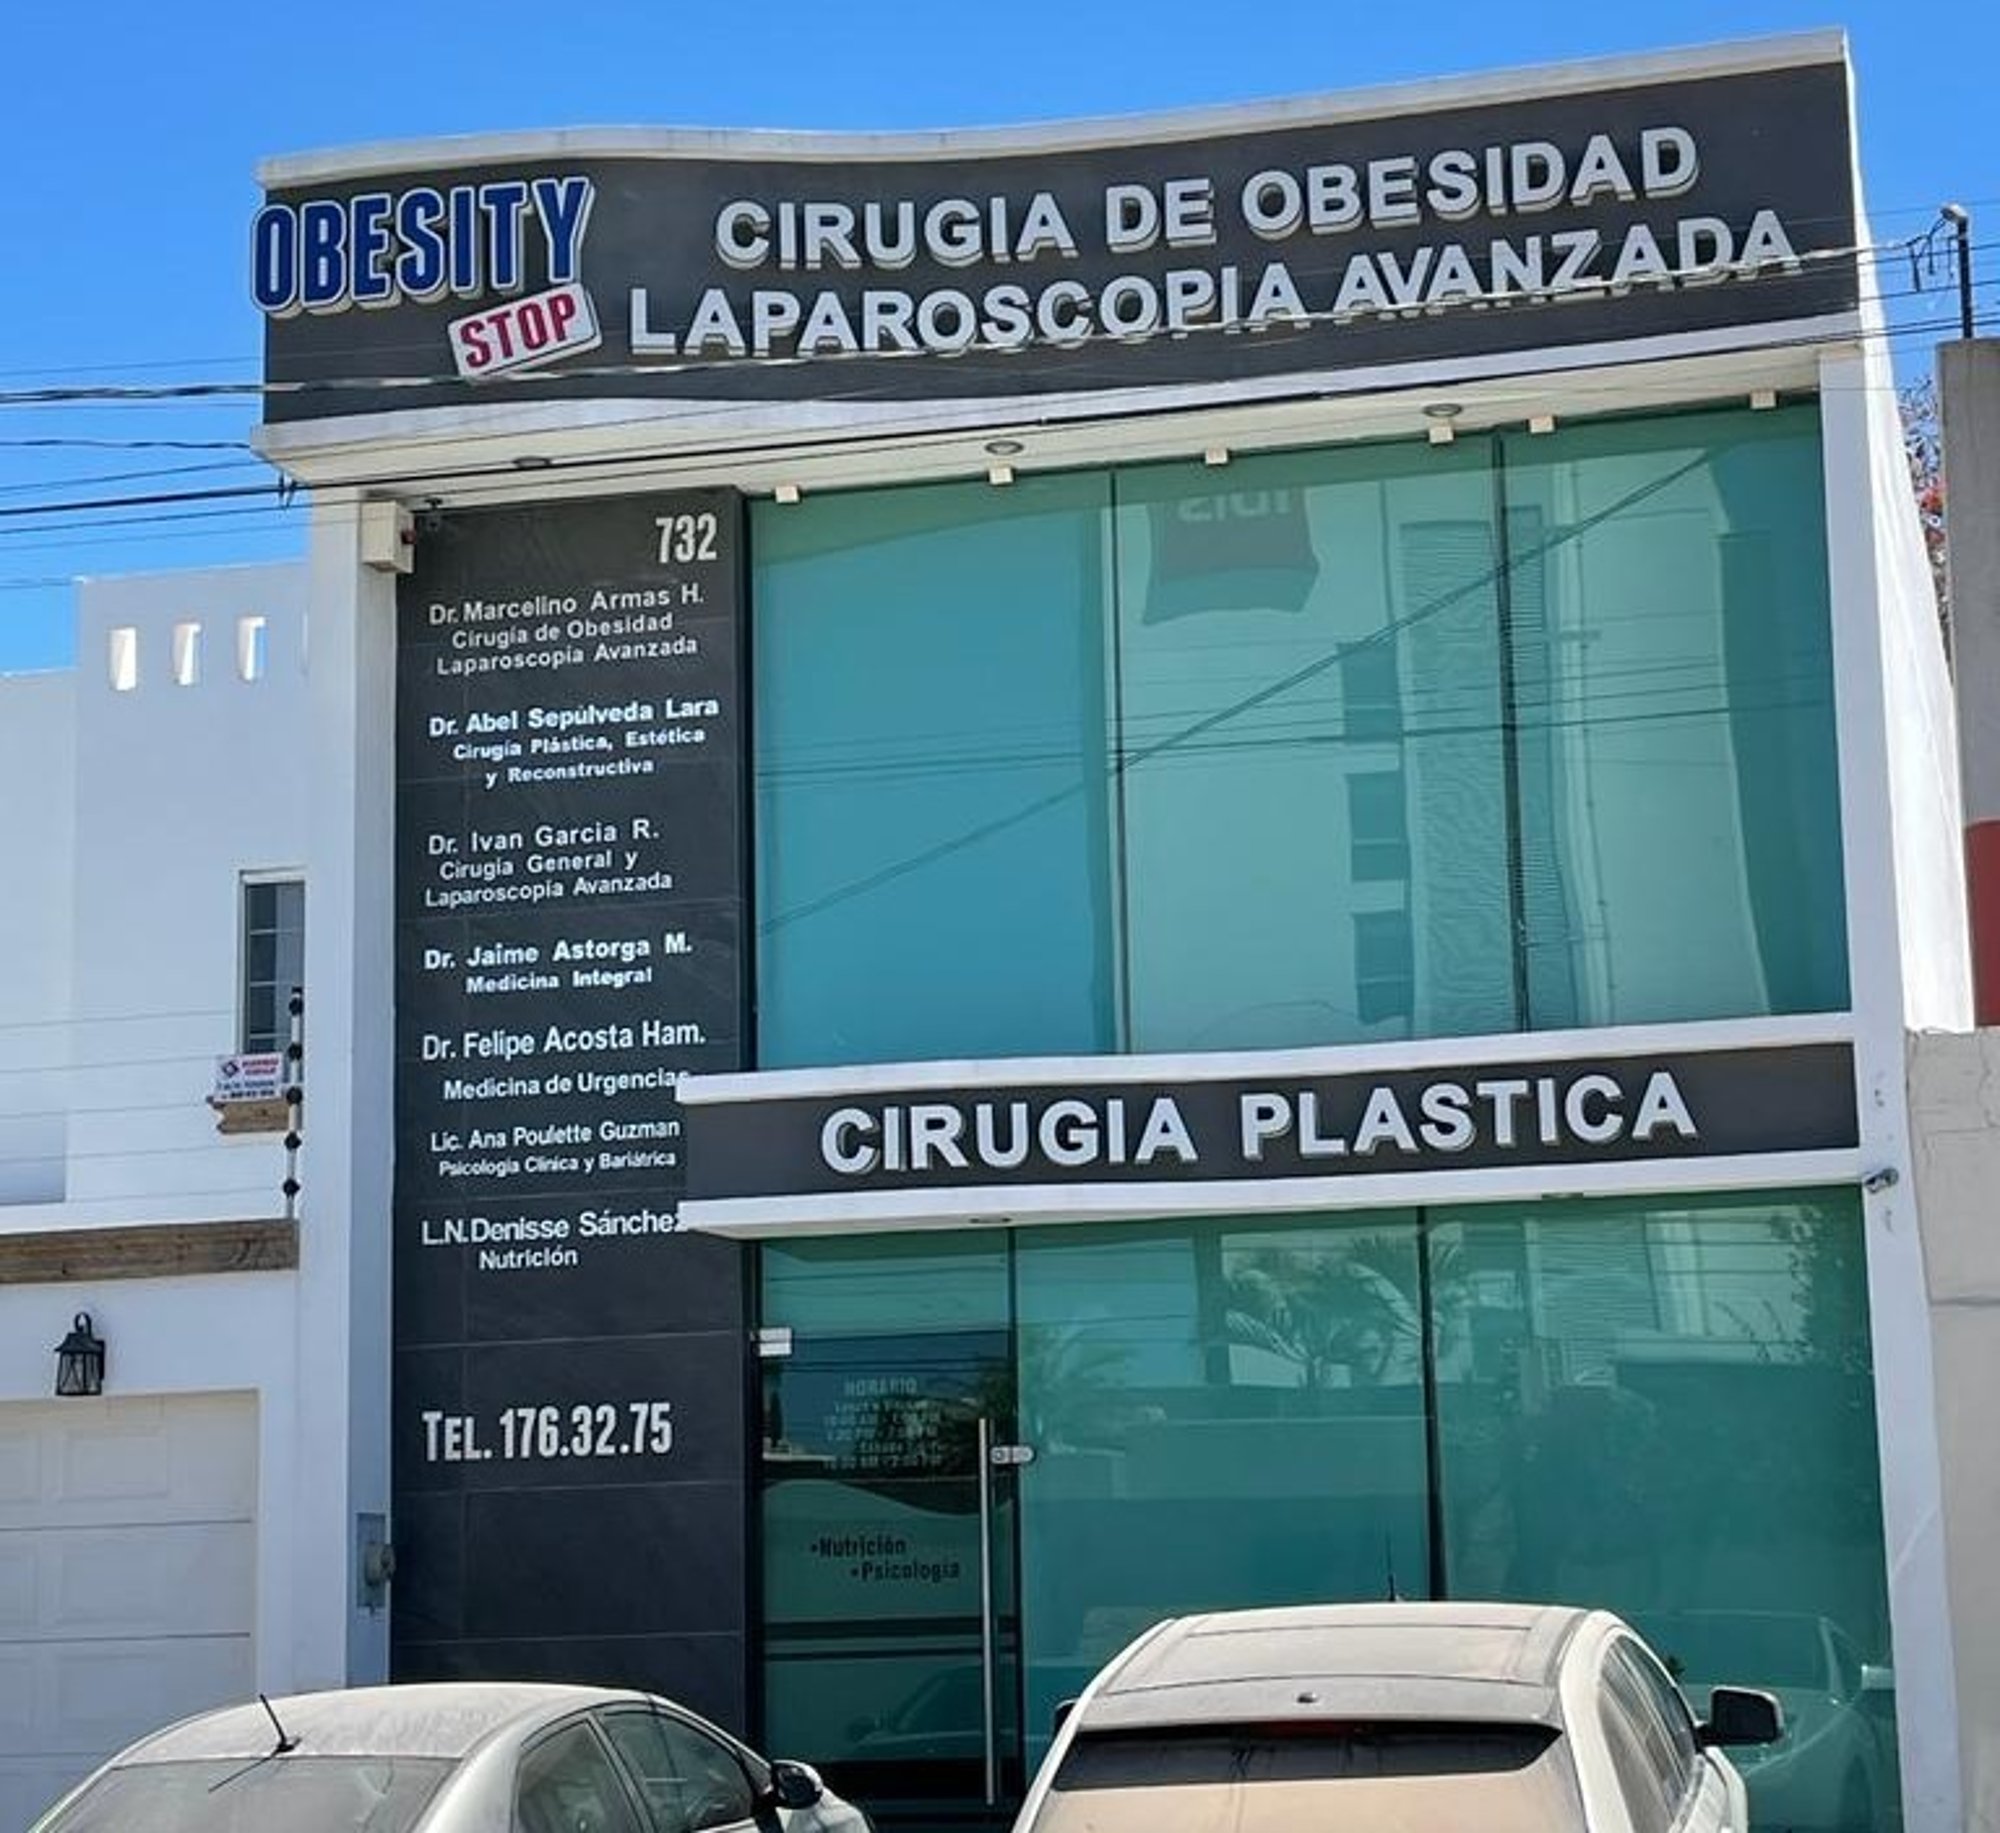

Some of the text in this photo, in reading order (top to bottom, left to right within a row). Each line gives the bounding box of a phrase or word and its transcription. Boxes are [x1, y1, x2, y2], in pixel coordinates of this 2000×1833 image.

[717, 126, 1701, 267] CIRUGIA DE OBESIDAD
[253, 176, 594, 318] OBESITY
[631, 209, 1800, 356] LAPAROSCOPIA AVANZADA
[459, 293, 577, 369] STOP
[655, 512, 719, 564] 732
[590, 588, 671, 613] Armas
[680, 583, 704, 605] H.
[535, 622, 561, 643] de
[567, 612, 674, 639] Obesidad
[437, 635, 699, 677] Laparoscopia Avanzada
[429, 715, 458, 738] Dr.
[466, 710, 519, 735] Abel
[666, 697, 720, 719] Lara
[625, 726, 706, 748] Estética
[485, 758, 654, 790] y Reconstructiva
[428, 834, 458, 856] Dr.
[472, 831, 524, 853] Ivan
[631, 819, 660, 840] R.
[526, 850, 613, 874] General
[625, 851, 639, 870] y
[426, 872, 673, 909] Laparoscopia Avanzada
[424, 932, 693, 970] Dr. Jaime Astorga M.
[465, 967, 653, 994] Medicina Integral
[422, 1020, 706, 1061] Dr. Felipe Acosta Ham.
[444, 1077, 541, 1101] Medicina
[548, 1073, 573, 1094] de
[431, 1119, 681, 1152] Lic. Ana Poulette Guzman
[821, 1072, 1697, 1177] CIRUGIA PLASTICA
[583, 1155, 595, 1174] y
[479, 1246, 579, 1271] Nutrición
[499, 1401, 674, 1459] 176.32.75
